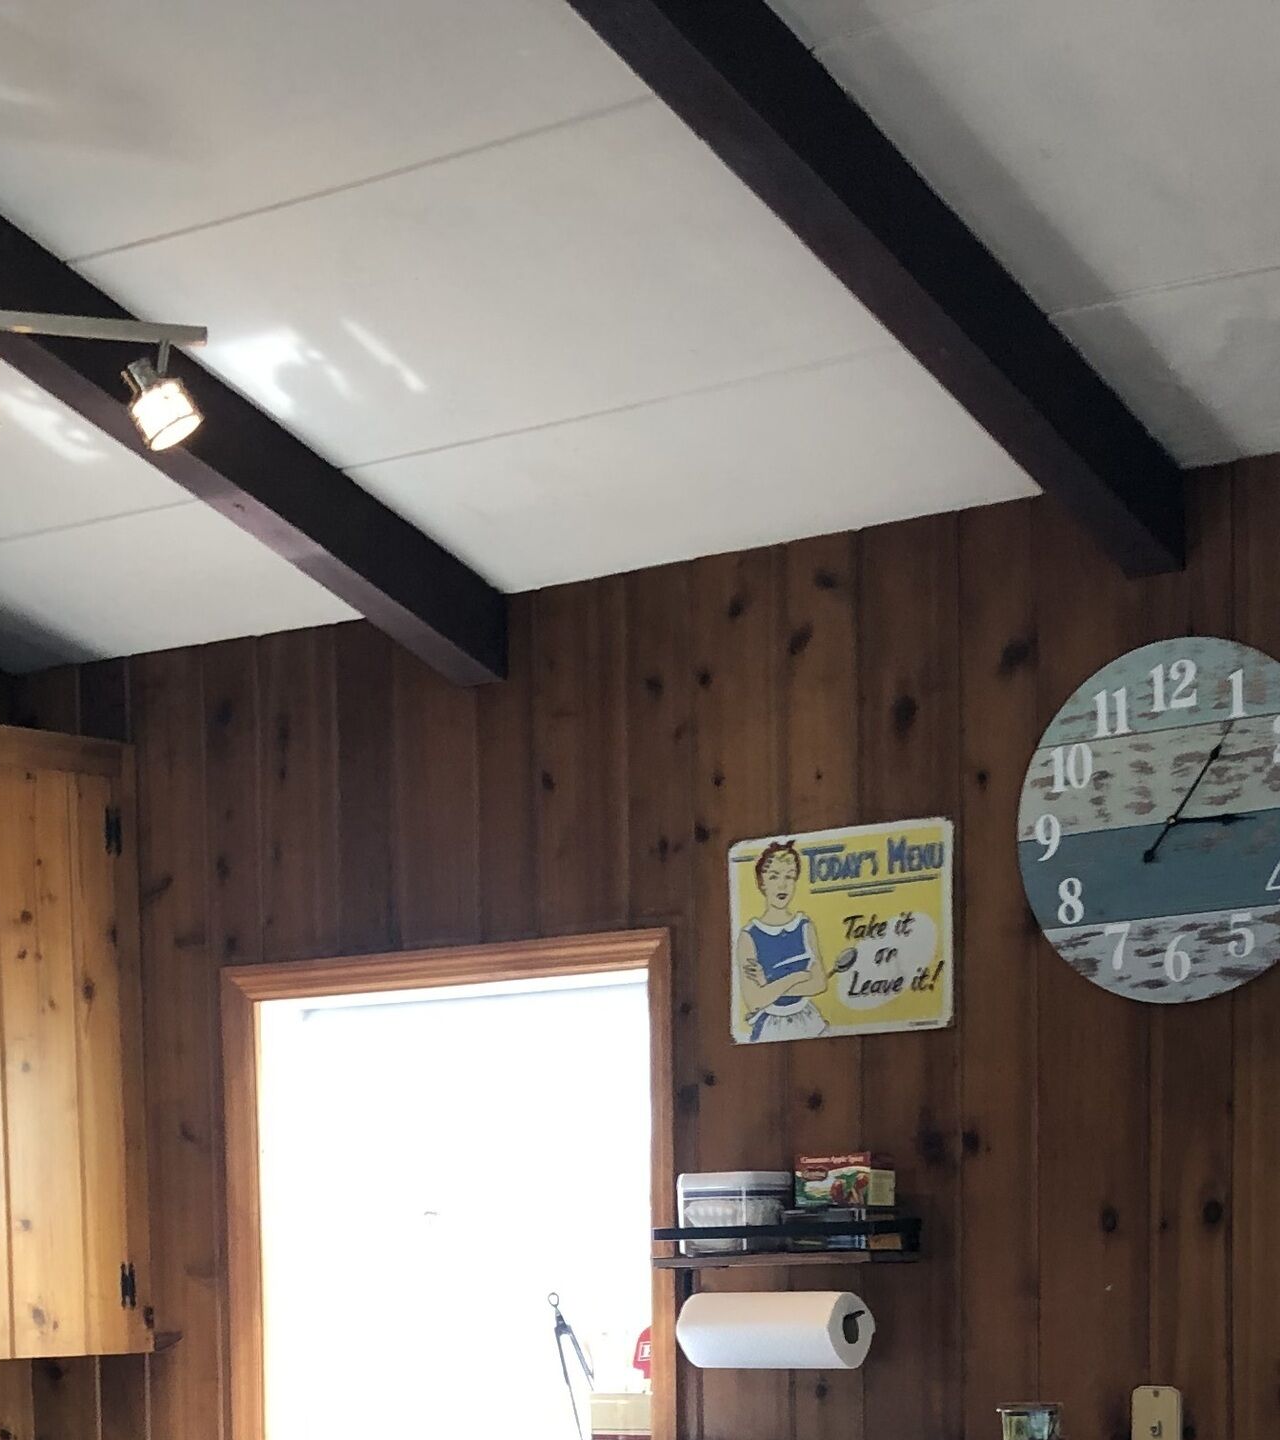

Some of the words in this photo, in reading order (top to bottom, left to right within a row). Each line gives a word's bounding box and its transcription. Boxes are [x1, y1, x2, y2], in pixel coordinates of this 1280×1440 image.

[1149, 659, 1198, 712] 12
[1226, 668, 1247, 718] 1
[1093, 686, 1133, 739] 11
[1050, 742, 1094, 793] 10
[886, 835, 945, 875] MENU
[1034, 813, 1062, 862] 9
[1057, 877, 1085, 925] 8
[842, 912, 887, 942] Take
[893, 910, 918, 938] it
[1104, 922, 1132, 971] 7
[1227, 913, 1256, 958] 5
[847, 970, 905, 997] Leave
[910, 959, 945, 992] it!
[874, 946, 899, 967] or
[1164, 934, 1192, 983] 6
